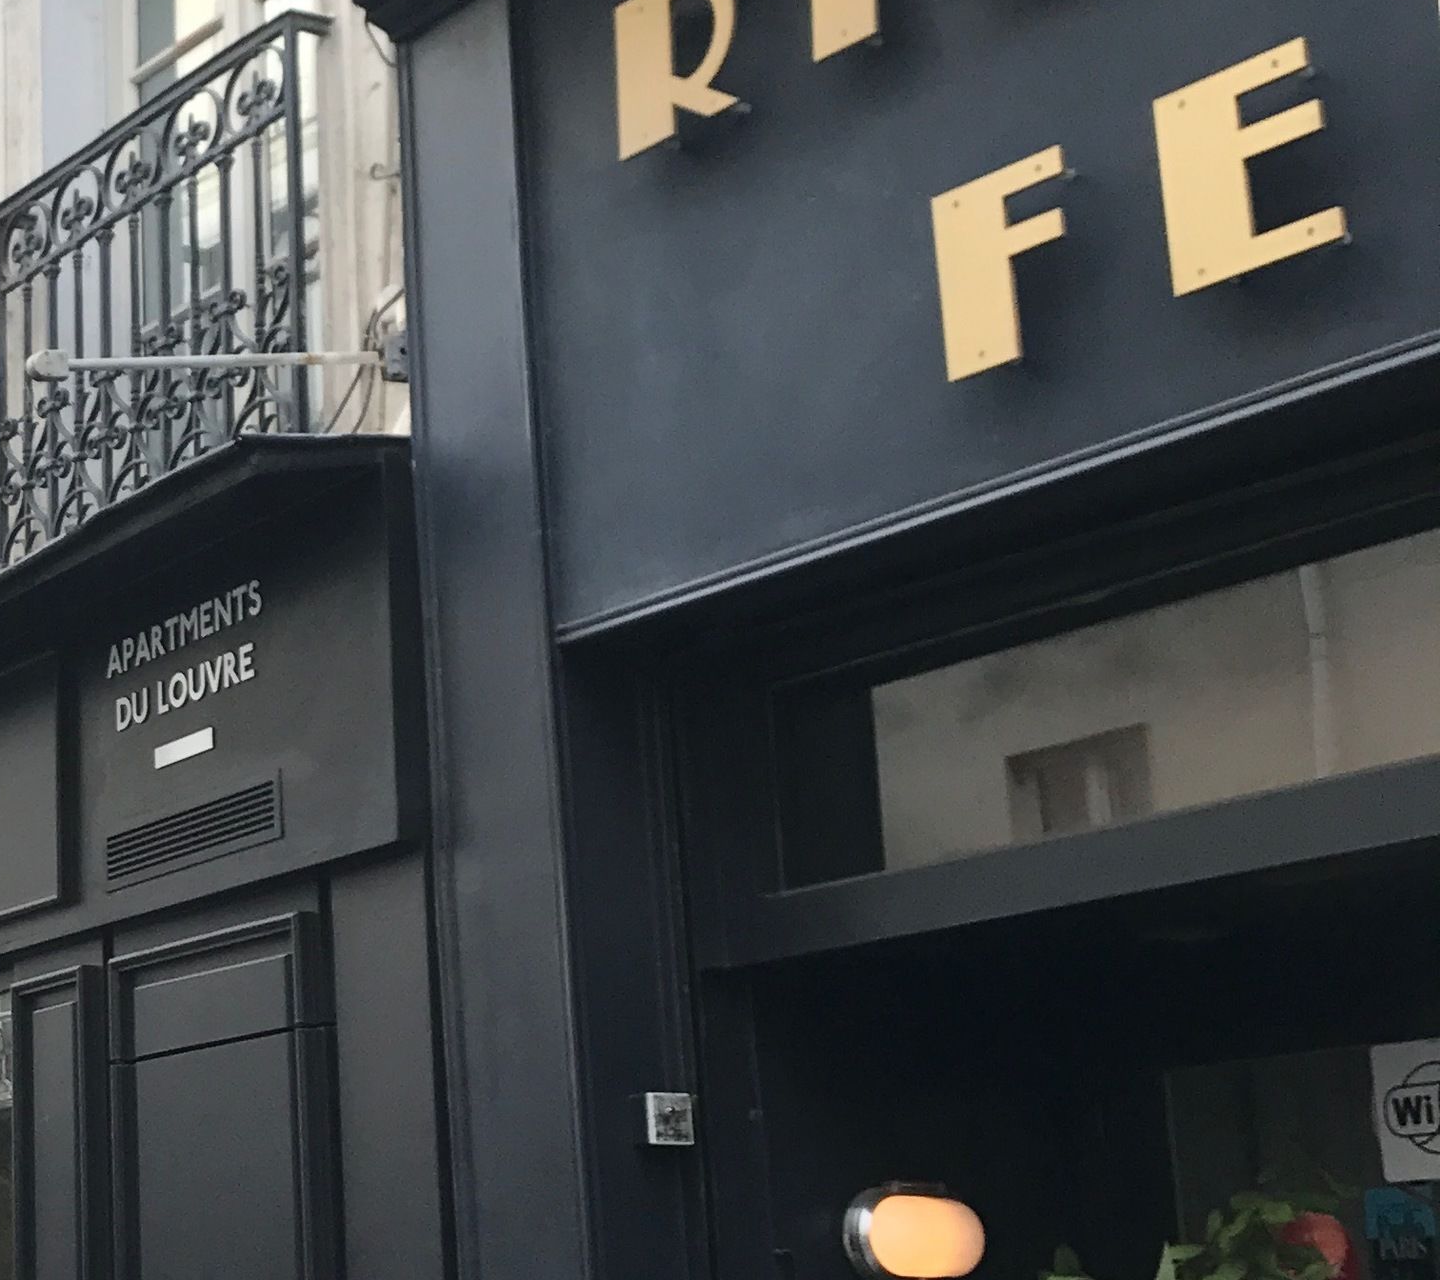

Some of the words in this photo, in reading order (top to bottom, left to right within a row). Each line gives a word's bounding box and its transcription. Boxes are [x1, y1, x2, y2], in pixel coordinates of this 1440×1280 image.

[106, 578, 264, 680] APARTMENTS
[115, 686, 150, 733] DU
[157, 642, 257, 716] LOUVRE
[1391, 1094, 1434, 1127] Wi
